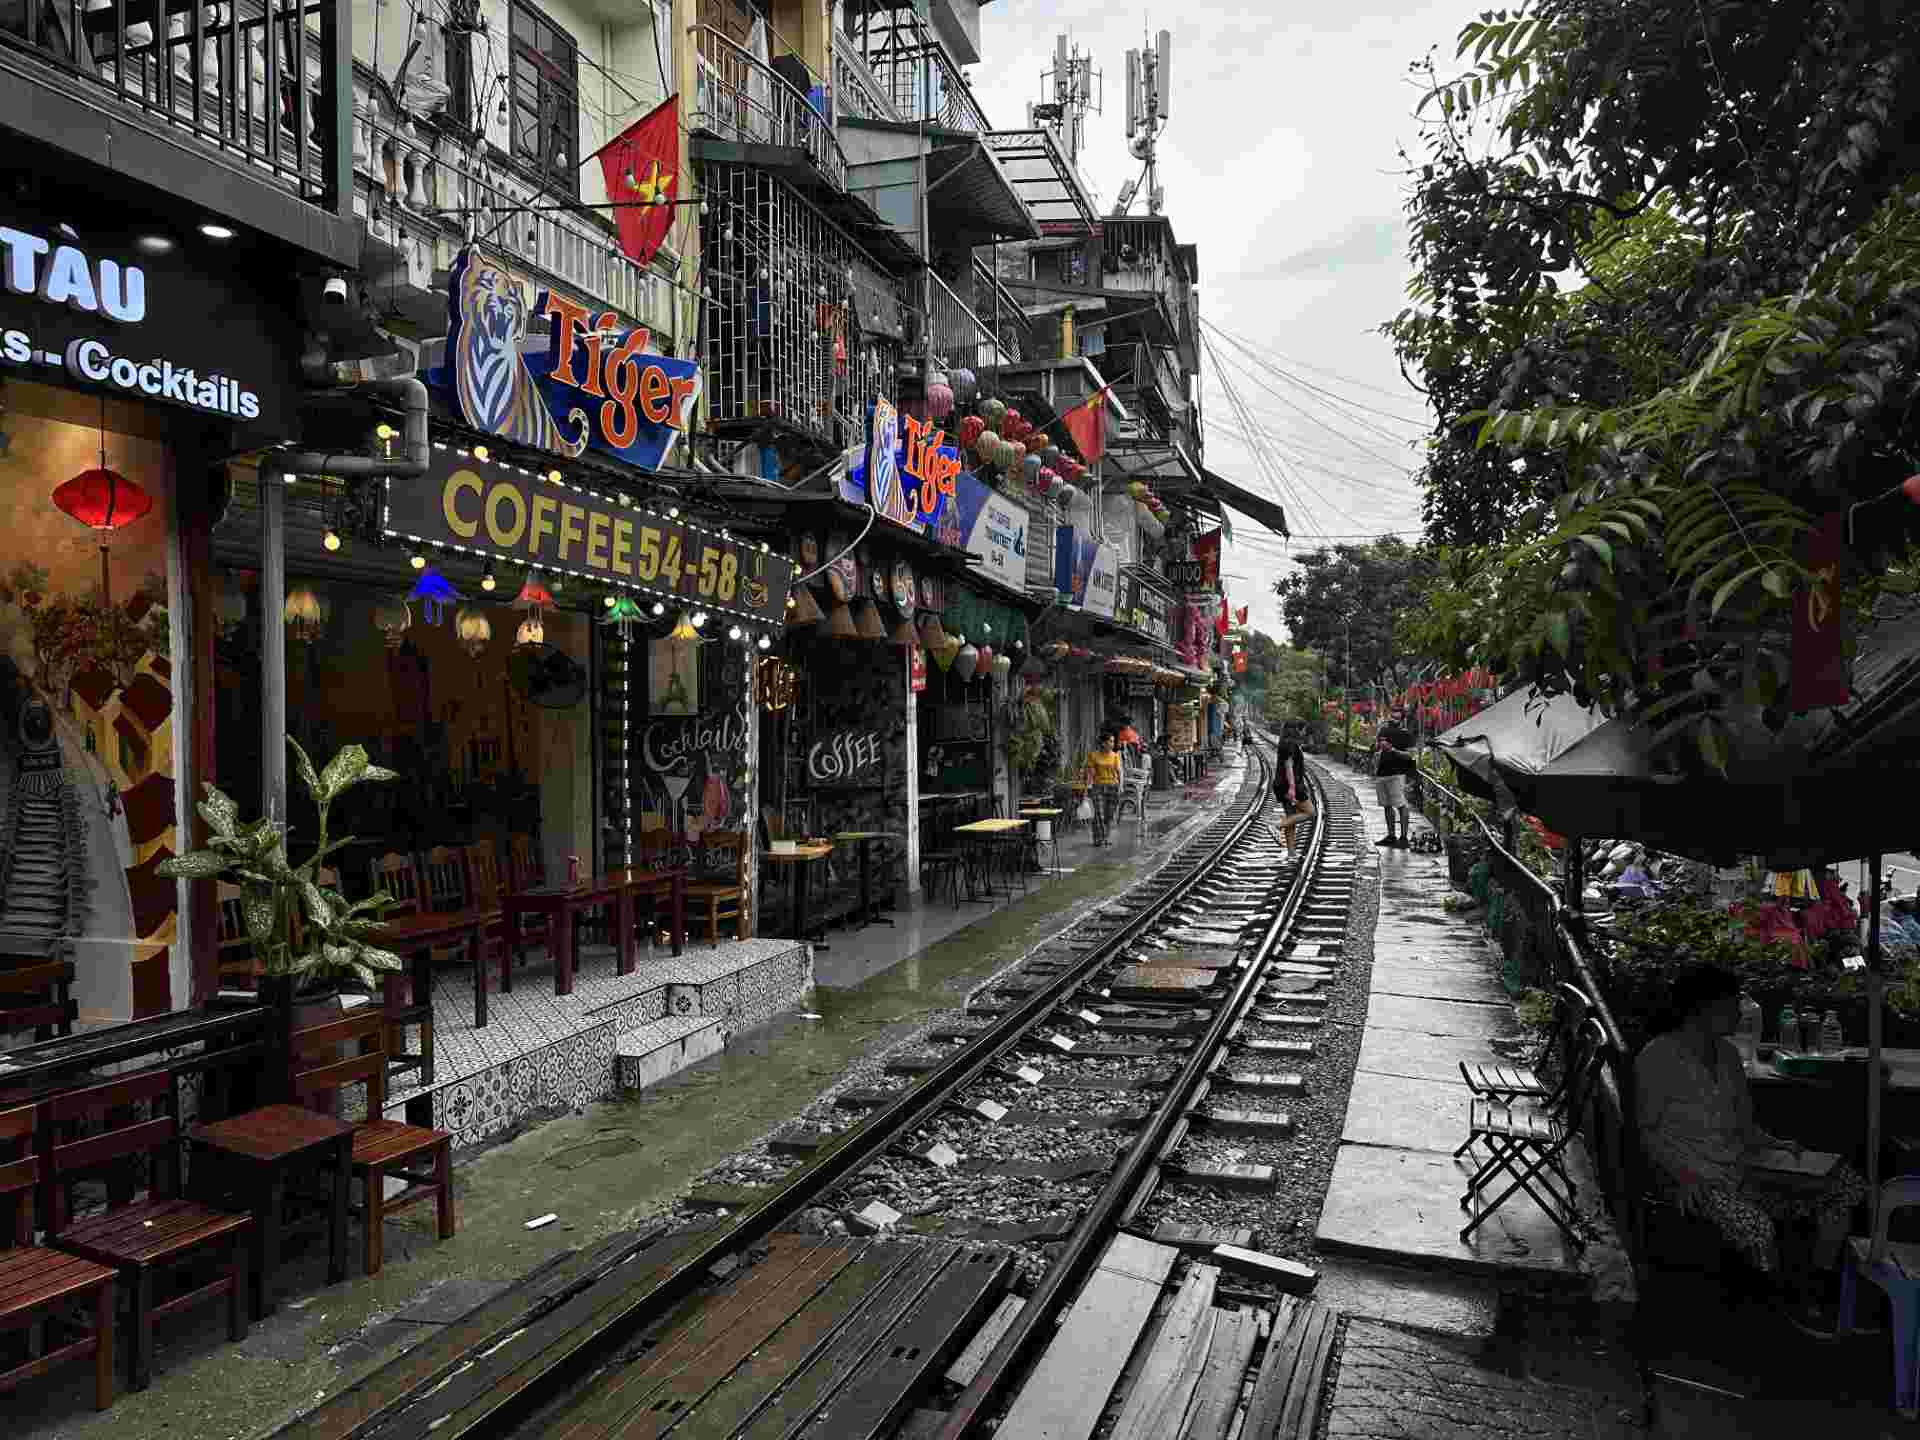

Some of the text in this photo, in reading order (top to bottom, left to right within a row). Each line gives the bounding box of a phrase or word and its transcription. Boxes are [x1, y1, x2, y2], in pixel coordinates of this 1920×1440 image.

[76, 340, 260, 418] Cocktails
[540, 287, 701, 450] Tiger
[904, 414, 962, 513] Tiger
[442, 468, 737, 602] COFFEE 54-58
